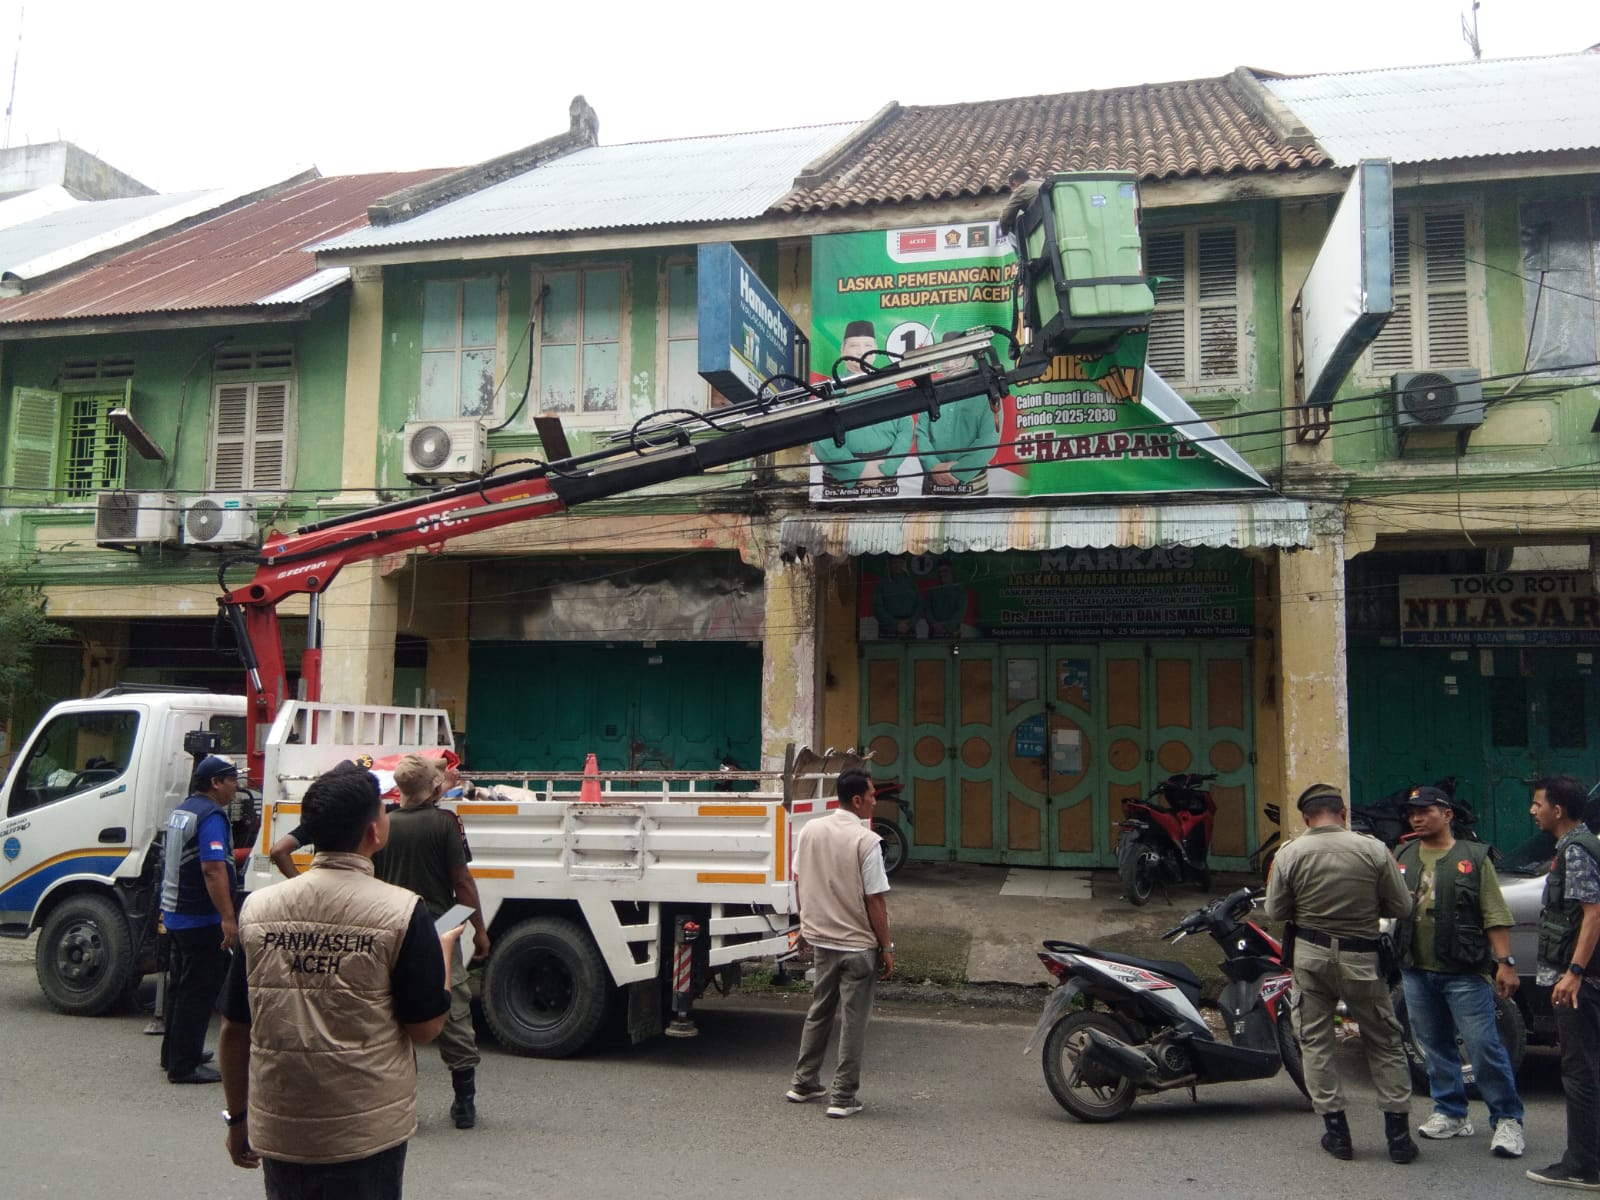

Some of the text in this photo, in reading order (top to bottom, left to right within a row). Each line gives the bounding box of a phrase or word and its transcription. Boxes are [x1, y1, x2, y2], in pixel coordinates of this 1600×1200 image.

[837, 275, 895, 293] LASKAR
[897, 267, 1001, 289] PEMENANGAN
[740, 266, 788, 347] Hannochs
[880, 285, 1010, 308] KABUPATEN ACEH
[900, 330, 916, 354] 1
[1016, 394, 1042, 409] Calon
[1044, 391, 1080, 407] Bupati
[1083, 391, 1104, 404] dan
[1016, 409, 1117, 428] Periode 2025-2030
[1015, 431, 1171, 461] #HARAPAN
[860, 486, 883, 496] Fahmi,
[884, 486, 898, 494] M.H
[1040, 548, 1195, 571] MARKAS
[1008, 573, 1062, 587] LASKAR
[1450, 576, 1577, 593] TOKO ROTI
[1001, 609, 1027, 624] Drs.
[1028, 608, 1067, 624] ARMIA
[1068, 608, 1110, 625] FAHMI,
[1136, 608, 1163, 623] DAN
[1164, 607, 1211, 624] ISMAIL,
[1404, 597, 1600, 629] NILASAR
[263, 931, 375, 954] PANWASLIH
[289, 954, 341, 974] ACEH
